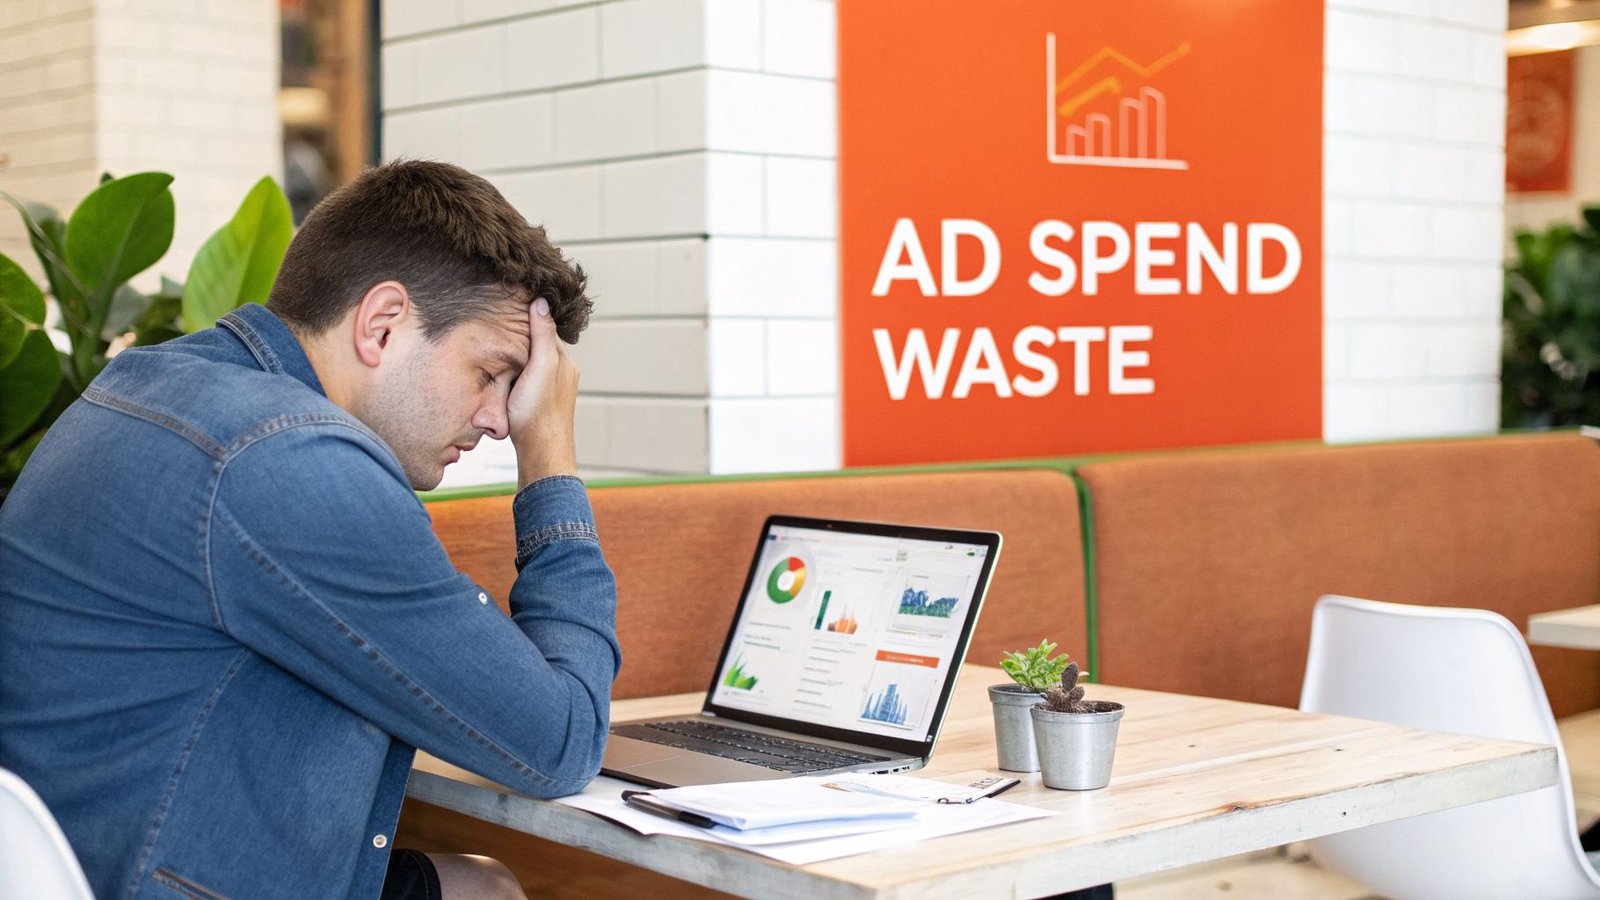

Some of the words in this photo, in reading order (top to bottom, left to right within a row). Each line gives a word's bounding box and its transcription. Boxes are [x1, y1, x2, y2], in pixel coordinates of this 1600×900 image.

[872, 218, 1001, 297] AD
[1028, 219, 1302, 296] SPEND
[873, 325, 1155, 400] WASTE
